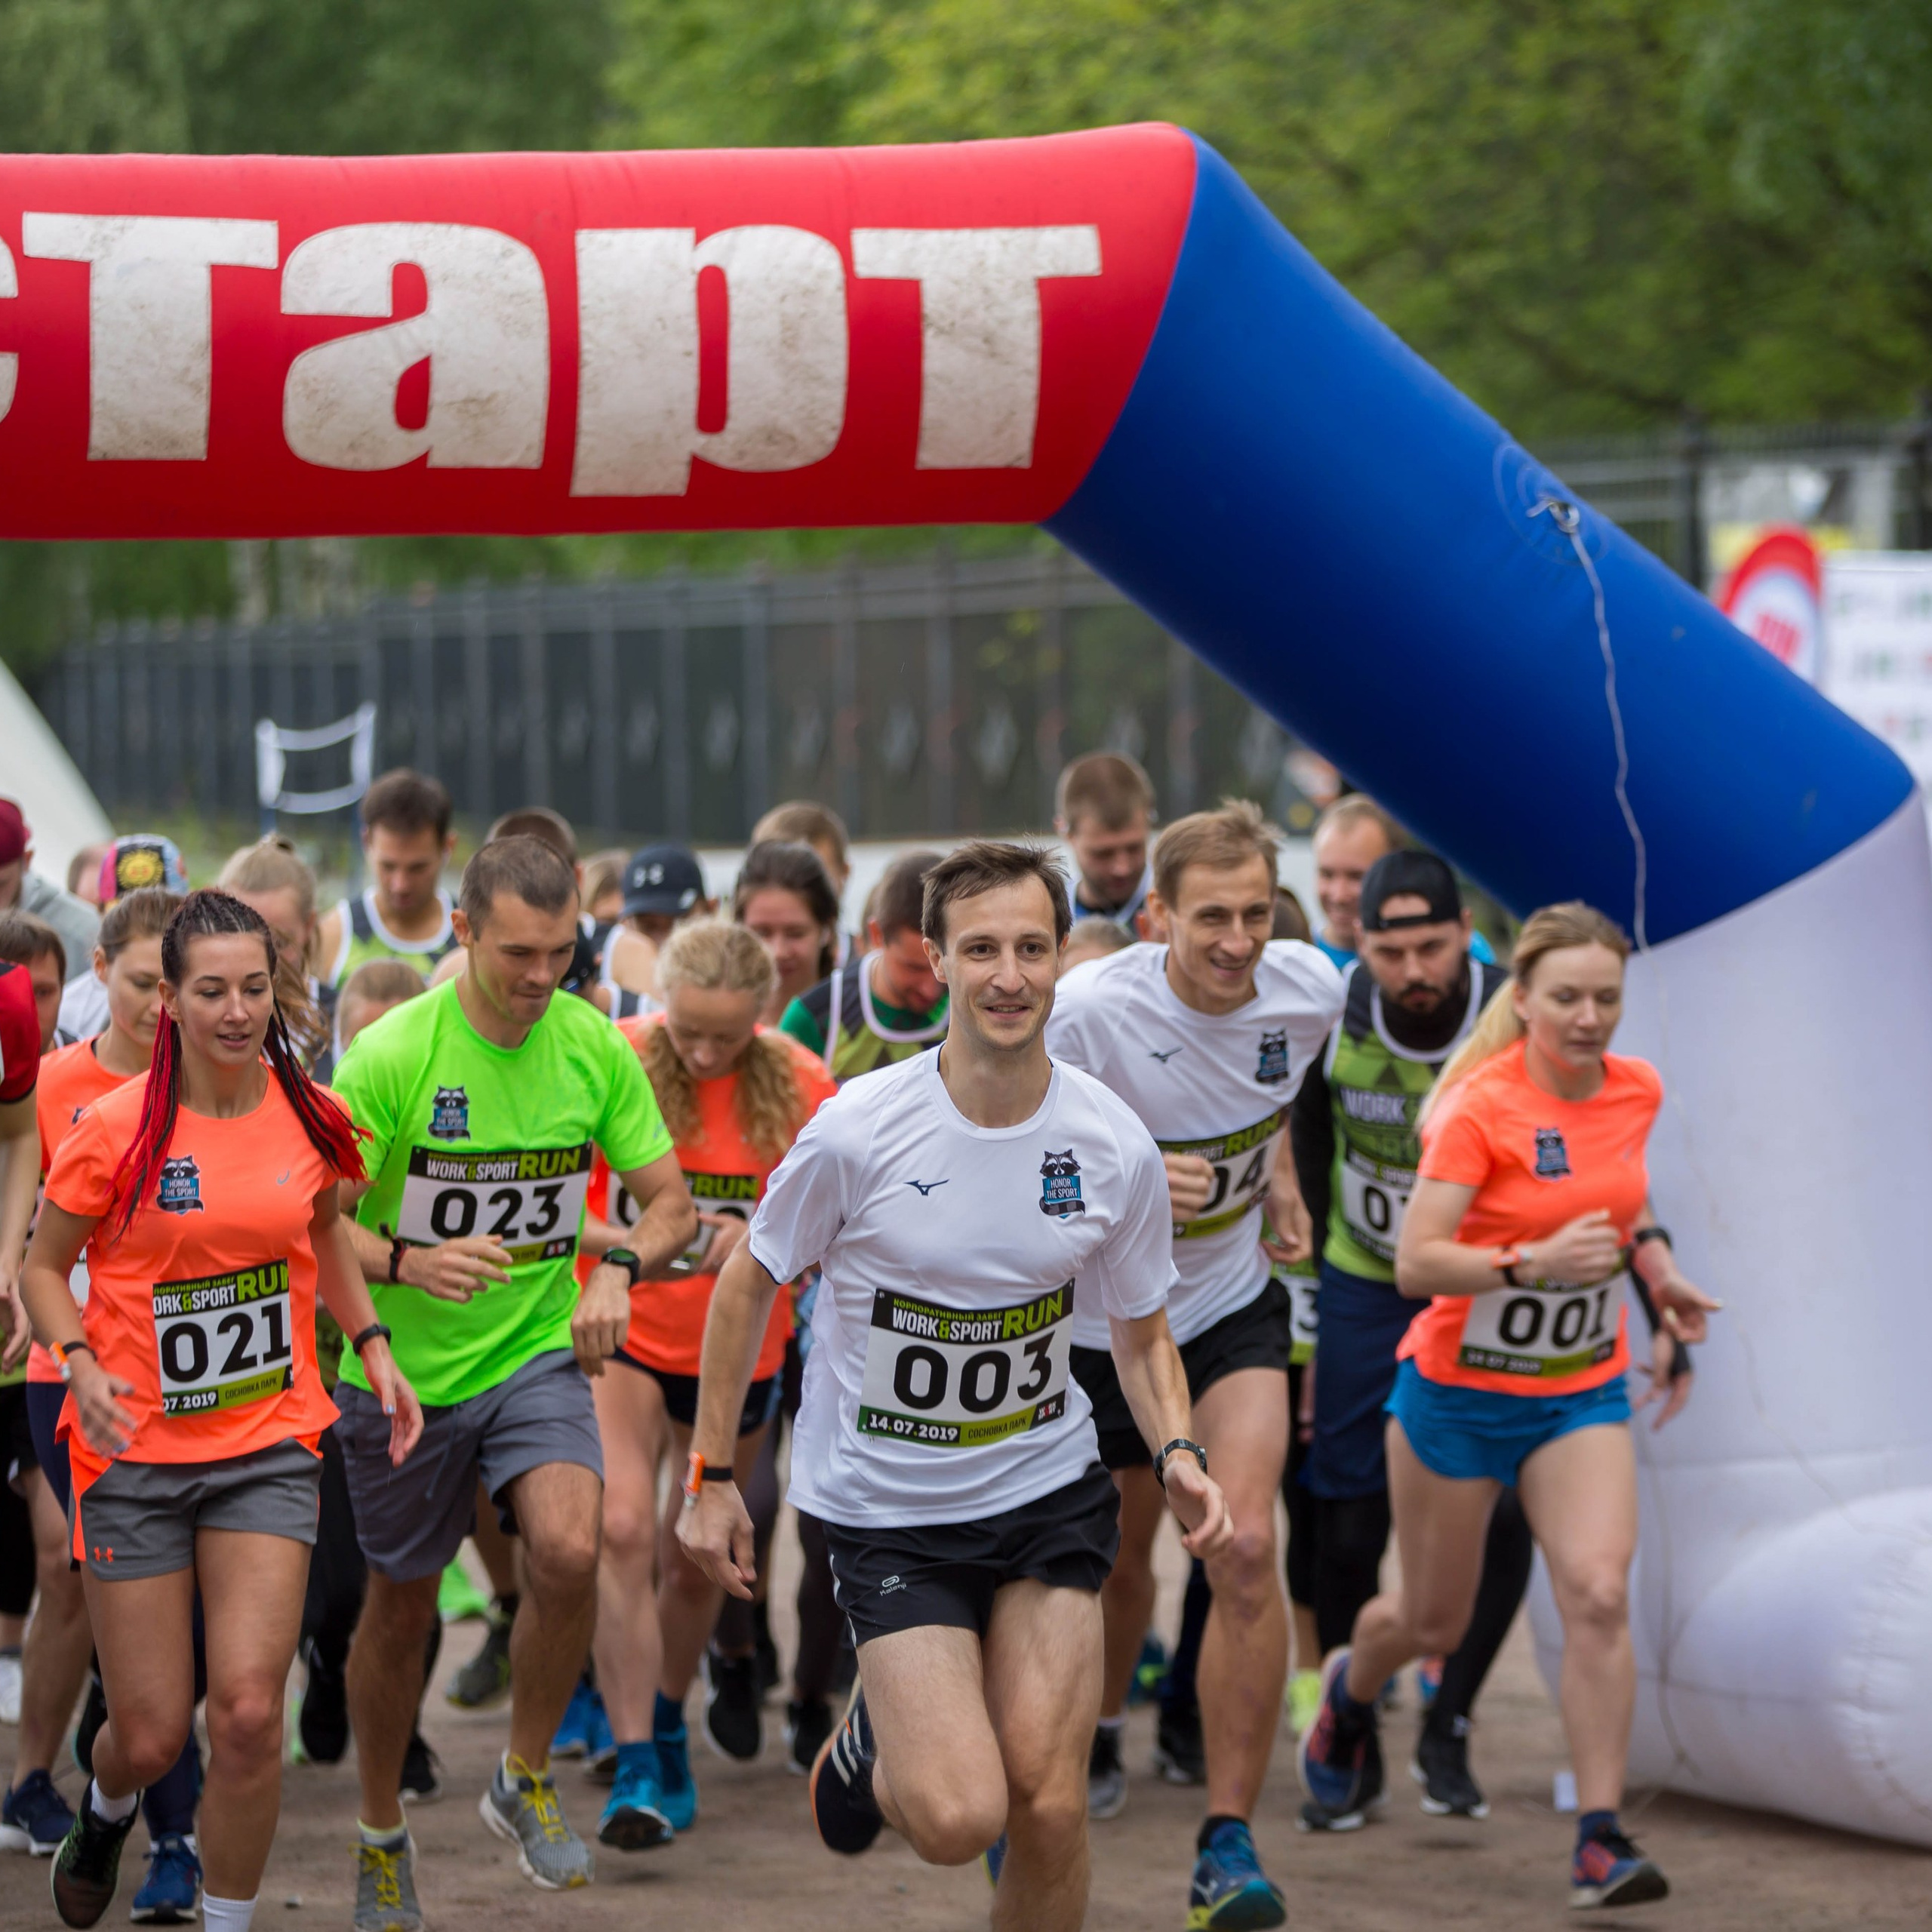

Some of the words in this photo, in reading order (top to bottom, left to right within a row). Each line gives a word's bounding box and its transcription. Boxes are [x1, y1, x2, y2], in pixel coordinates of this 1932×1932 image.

[0, 211, 1103, 497] тарт
[1224, 1112, 1281, 1157] RUN
[426, 1160, 518, 1180] WORK&SPORT
[518, 1149, 580, 1180] RUN
[1198, 1143, 1269, 1212] 04
[165, 1188, 175, 1198] THE
[177, 1187, 196, 1198] SPORT
[169, 1178, 191, 1189] HONOR
[694, 1175, 759, 1199] RUN
[1046, 1189, 1057, 1199] THE
[1057, 1187, 1078, 1198] SPORT
[1050, 1177, 1072, 1189] HONOR
[430, 1182, 565, 1240] 023
[152, 1284, 236, 1316] ORK&SPORT
[153, 1279, 211, 1296] ПОРАТИВНЫЙ
[892, 1306, 1003, 1342] WORK&SPORT
[1002, 1288, 1063, 1340] RUN
[893, 1297, 974, 1321] КОРПОРАТИВНЫЙ
[976, 1311, 1004, 1321] ЗАБЕГ
[1498, 1287, 1610, 1348] 001
[161, 1300, 291, 1383] 021
[893, 1330, 1056, 1414] 003
[163, 1391, 217, 1411] 07.2019
[225, 1380, 260, 1401] СОСНОВКА
[261, 1376, 278, 1390] ПАРК
[869, 1413, 958, 1441] 14.07.2019
[968, 1424, 1008, 1439] СОСНОВКА
[1009, 1416, 1028, 1432] ПАРК
[879, 1582, 907, 1597] Kalenji
